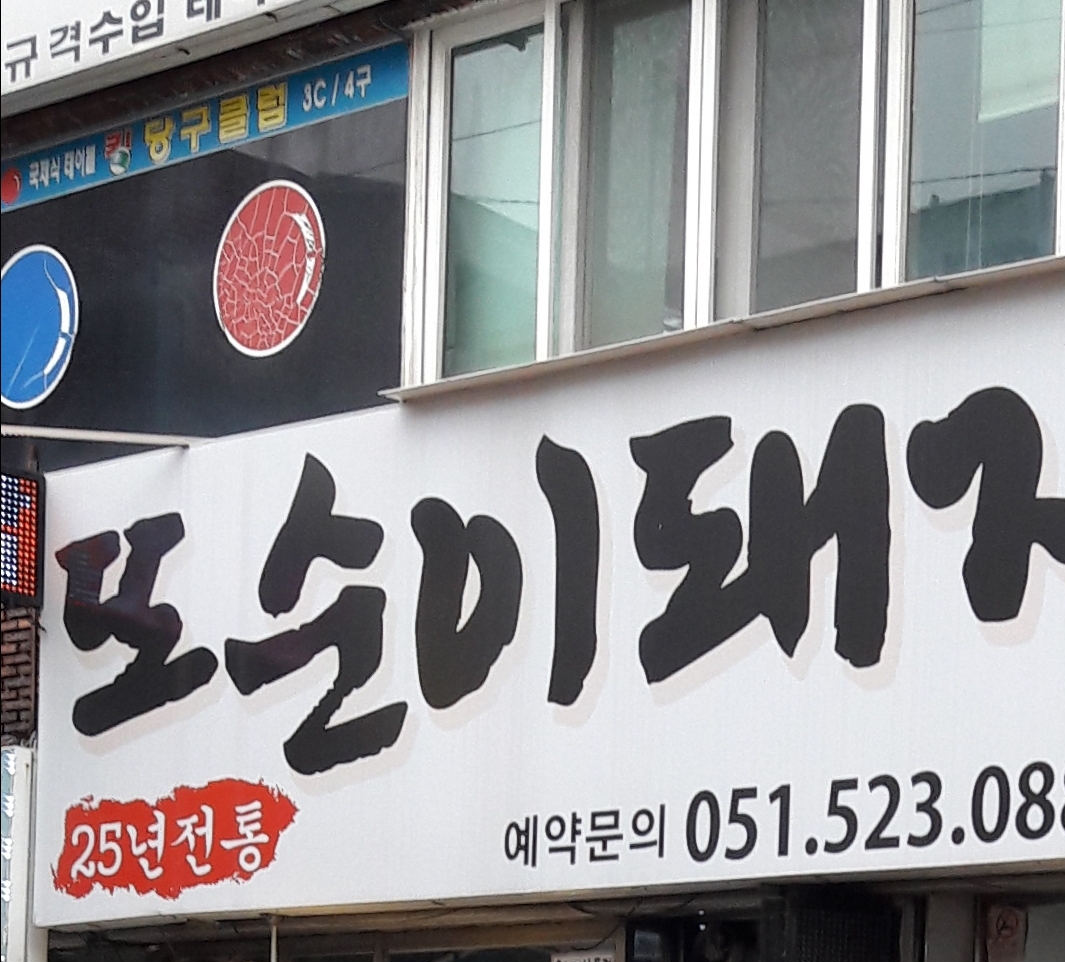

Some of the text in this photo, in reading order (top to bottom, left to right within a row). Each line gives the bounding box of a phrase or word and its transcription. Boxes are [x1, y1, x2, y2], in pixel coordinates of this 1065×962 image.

[143, 82, 288, 165] 당구클럽
[70, 800, 269, 880] 25년전통
[504, 802, 666, 867] 예약문의
